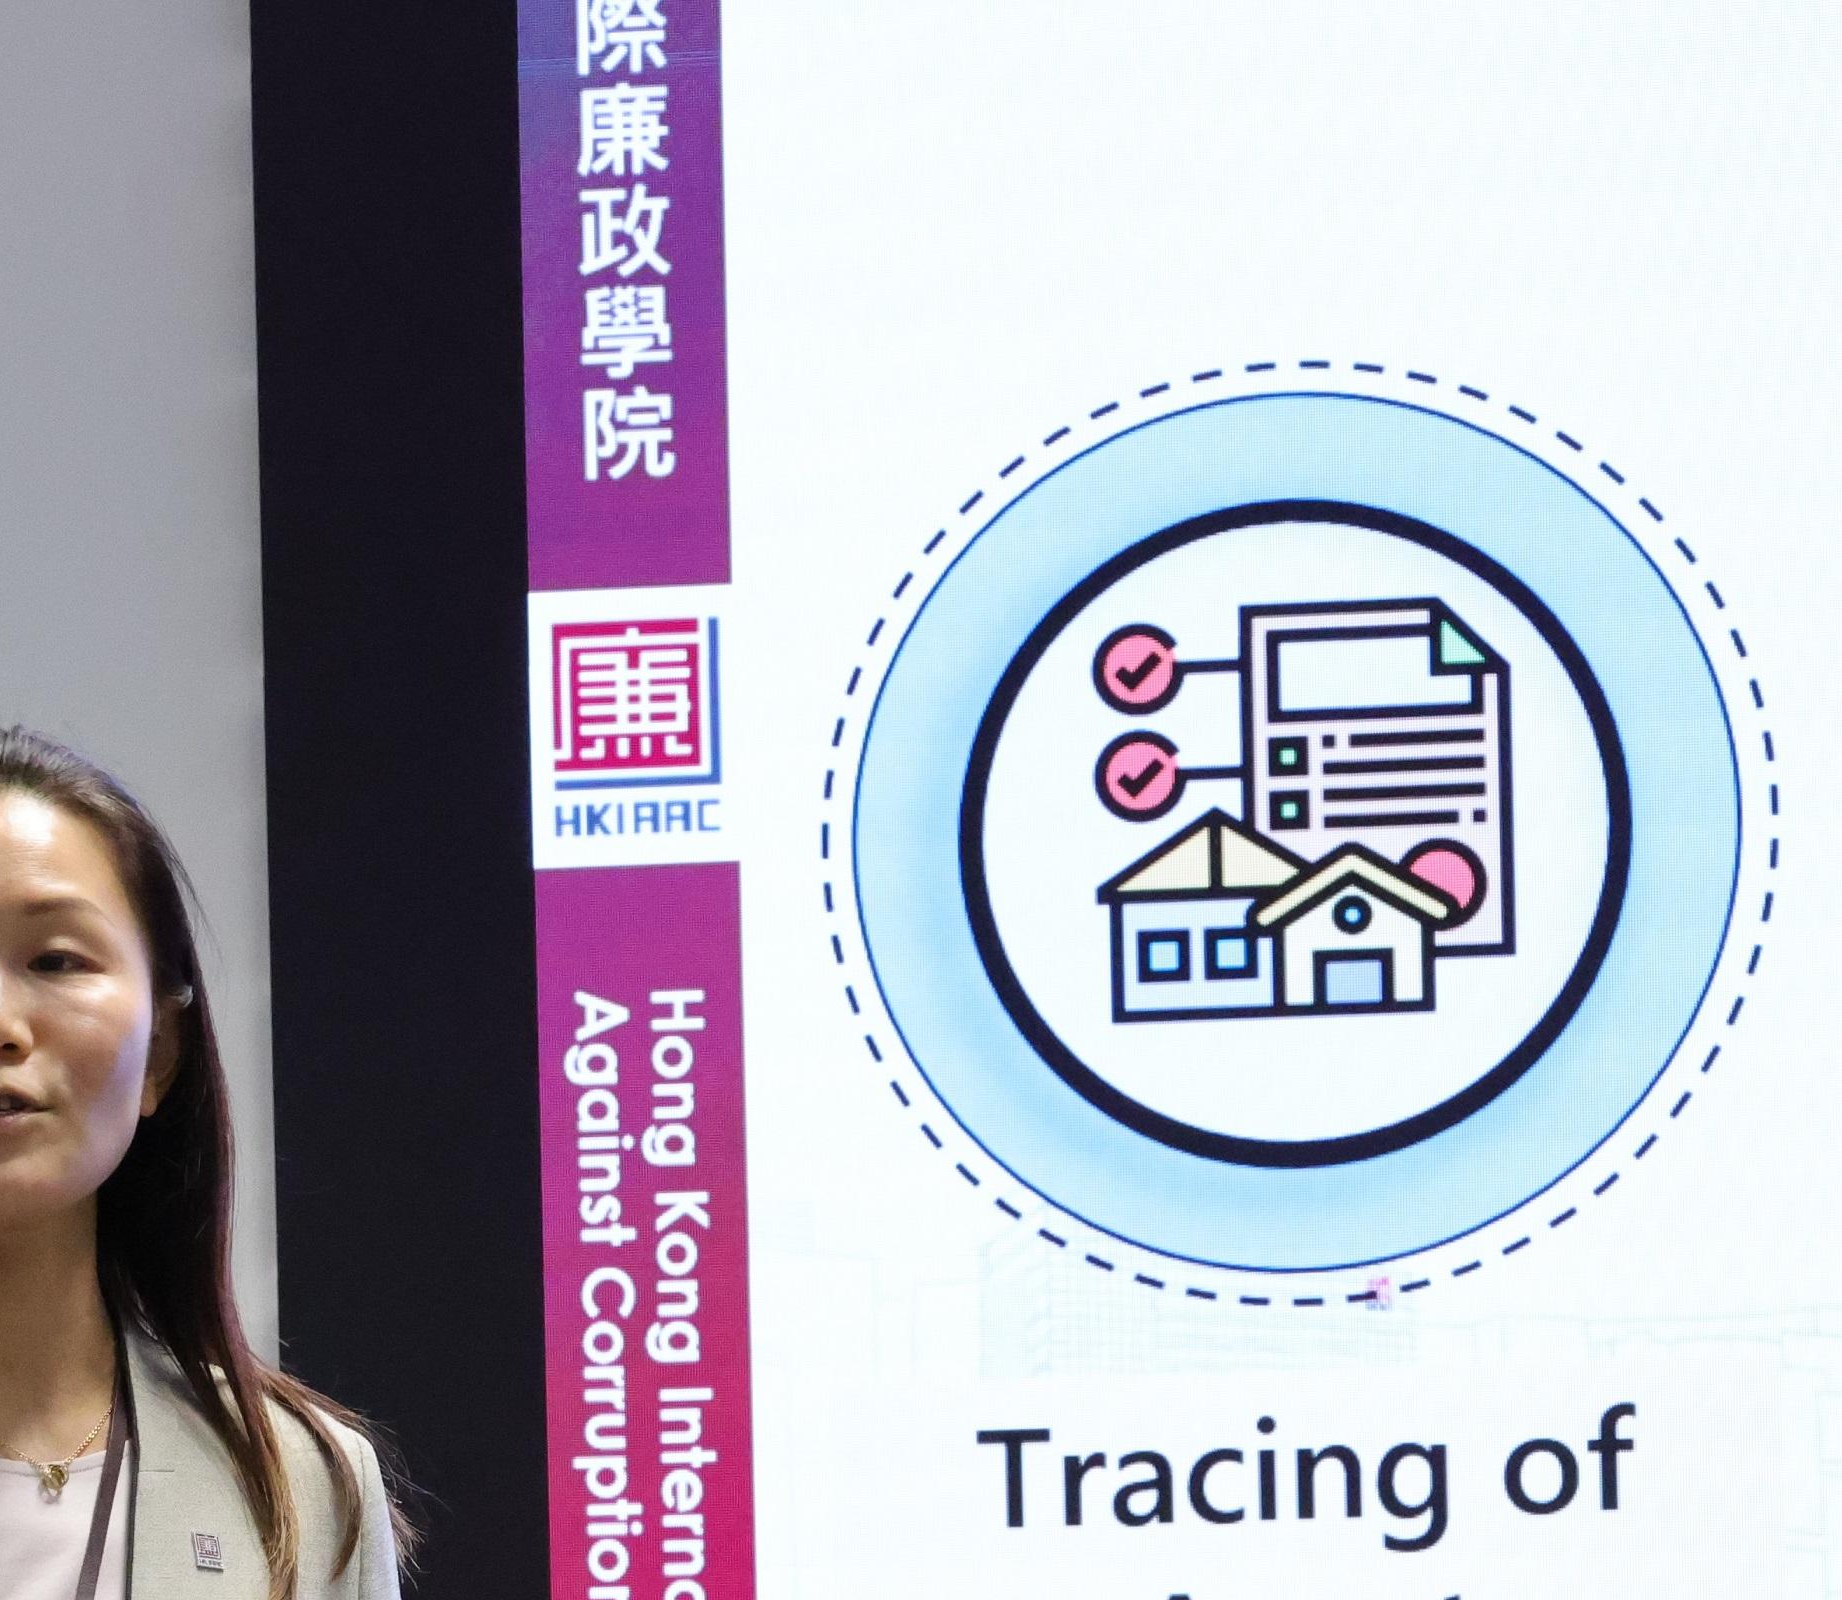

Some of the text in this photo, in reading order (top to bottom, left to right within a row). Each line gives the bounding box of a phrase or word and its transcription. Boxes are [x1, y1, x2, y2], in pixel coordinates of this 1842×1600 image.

[575, 0, 678, 483] 際廉政學院
[554, 798, 722, 837] HKIAAC
[563, 989, 638, 1248] Against
[640, 988, 706, 1166] Hong
[644, 1190, 711, 1364] Kong
[975, 1401, 1637, 1553] Tracing of
